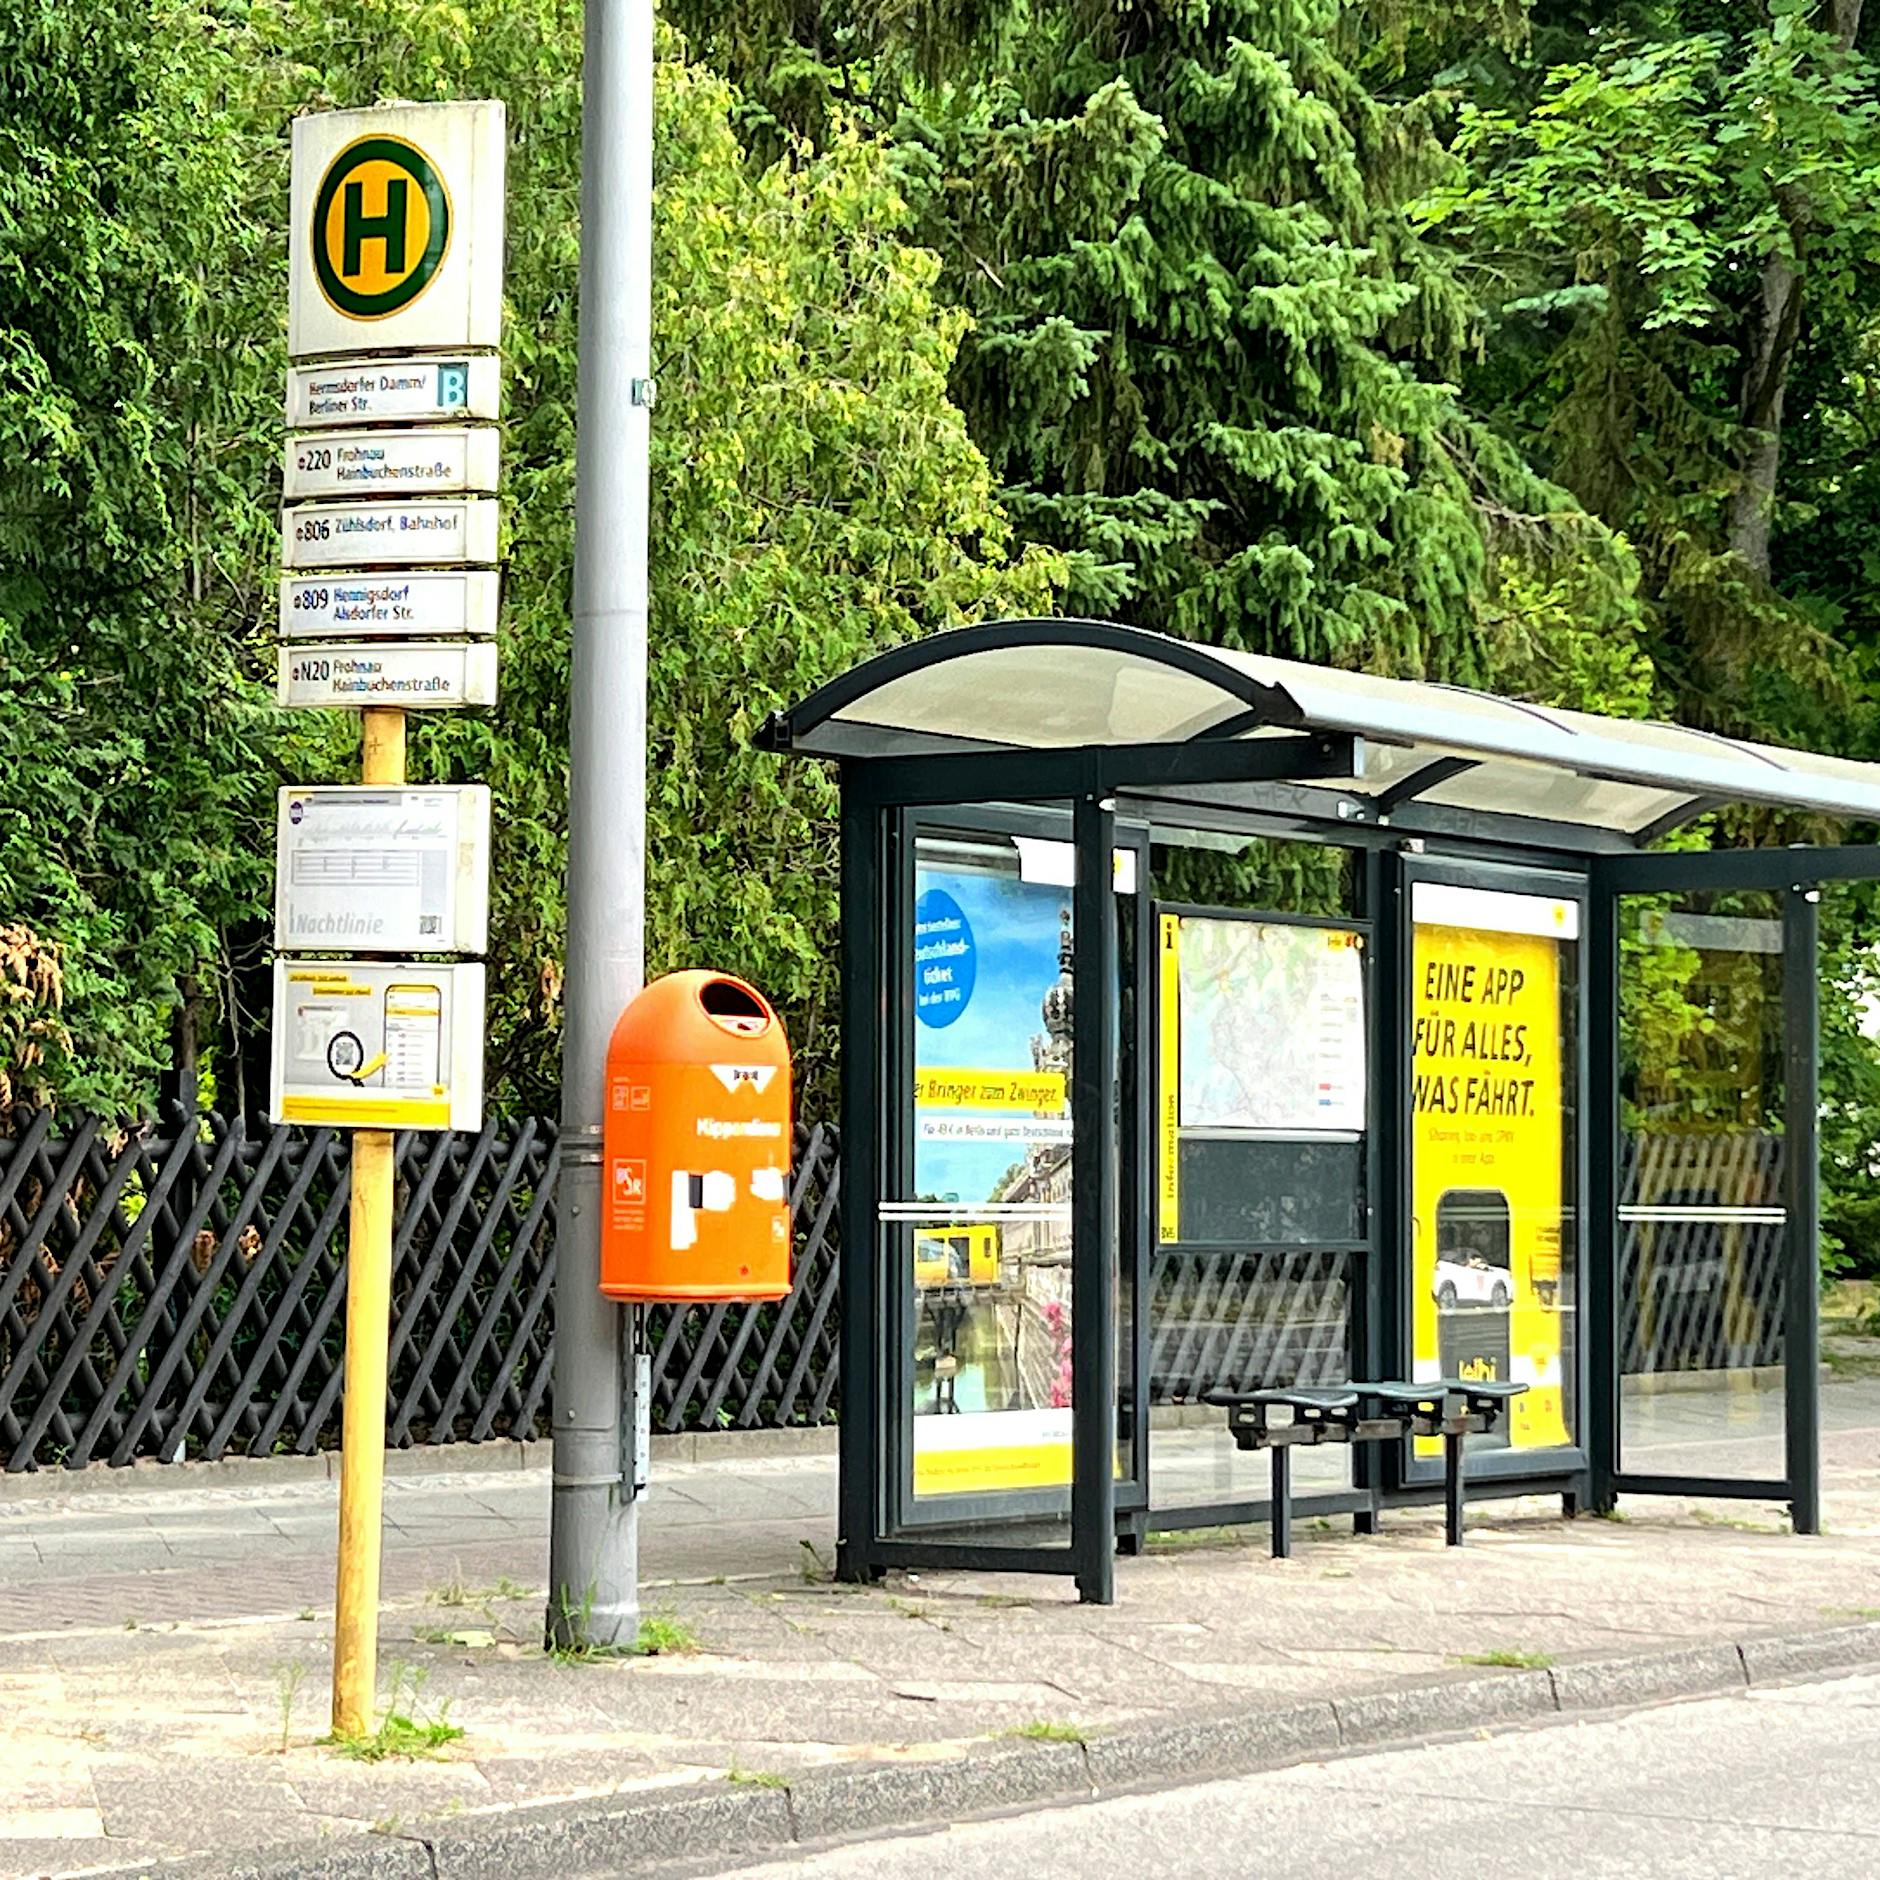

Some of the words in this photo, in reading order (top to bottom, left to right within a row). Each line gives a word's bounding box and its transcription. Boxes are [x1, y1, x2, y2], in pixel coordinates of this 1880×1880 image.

[341, 178, 407, 277] H
[443, 370, 466, 408] B
[306, 450, 331, 471] 220
[304, 519, 330, 541] 806
[400, 515, 458, 531] Bahnhof
[302, 588, 329, 609] 809
[393, 605, 414, 619] Str.
[301, 660, 329, 681] N20
[332, 658, 382, 674] Frohnau
[295, 909, 384, 935] Nachtlinie
[1425, 962, 1475, 1002] EINE
[1481, 967, 1524, 1005] APP
[1412, 1009, 1455, 1057] FÜR
[1461, 1021, 1532, 1067] ALLES,
[1465, 1070, 1535, 1117] FÄHRT.
